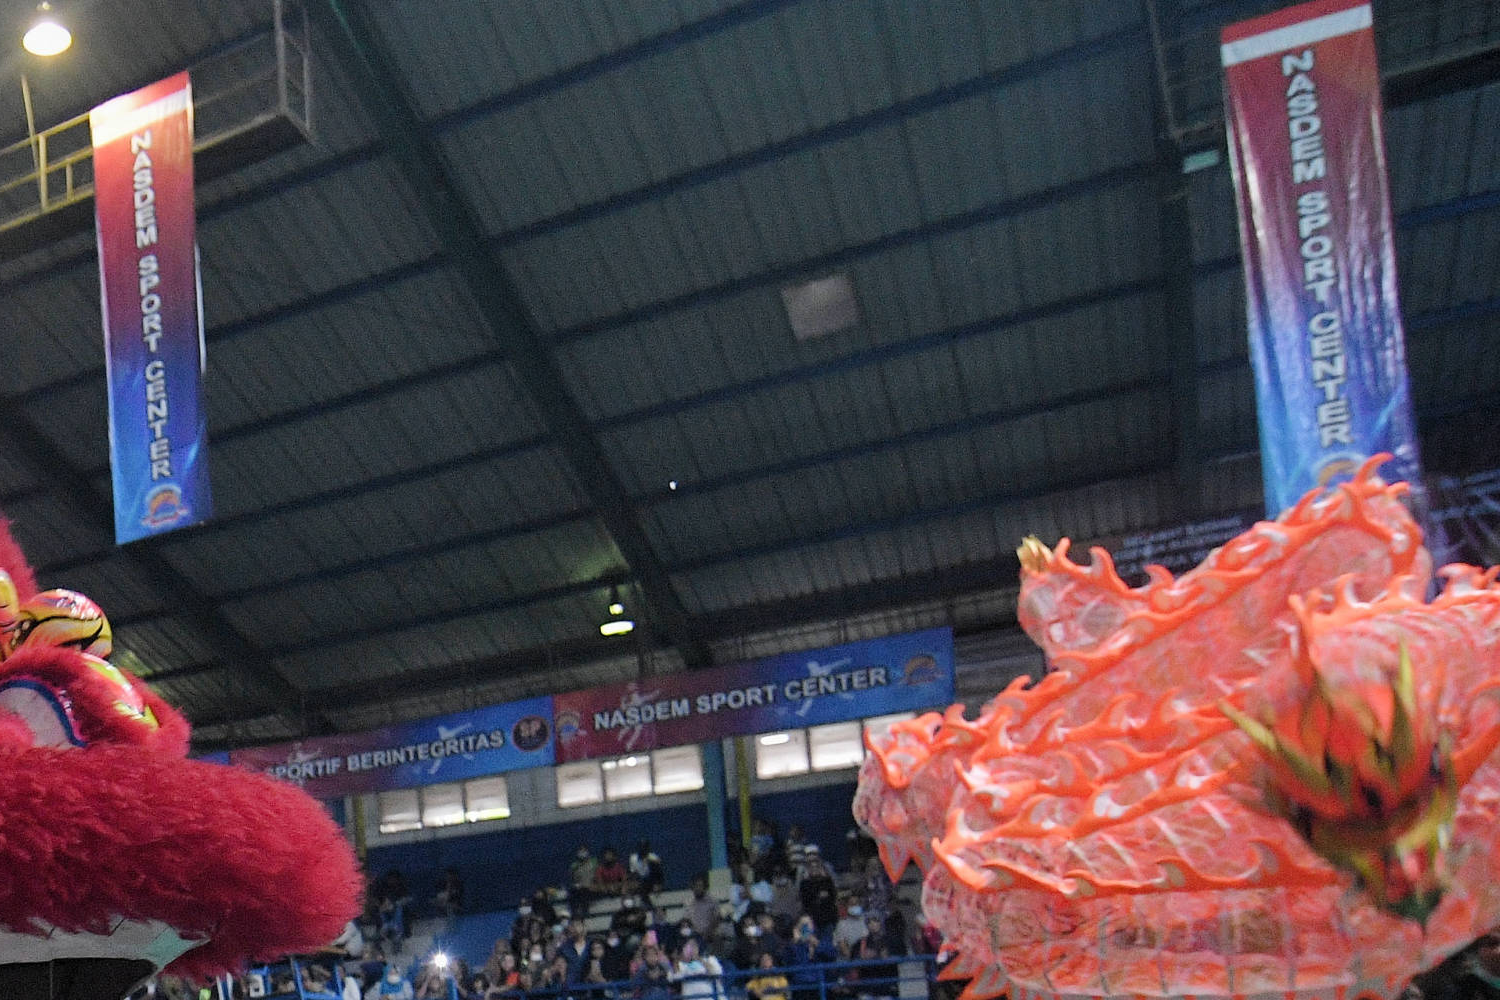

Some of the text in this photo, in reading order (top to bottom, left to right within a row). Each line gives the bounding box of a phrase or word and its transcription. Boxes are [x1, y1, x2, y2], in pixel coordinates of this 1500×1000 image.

[130, 129, 171, 481] NASDEM SPORT CENTER
[1281, 49, 1353, 448] NASDEM SPORT CENTER
[347, 730, 505, 772] BERINTEGRITAS
[594, 666, 888, 731] NASDEM SPORT CENTER
